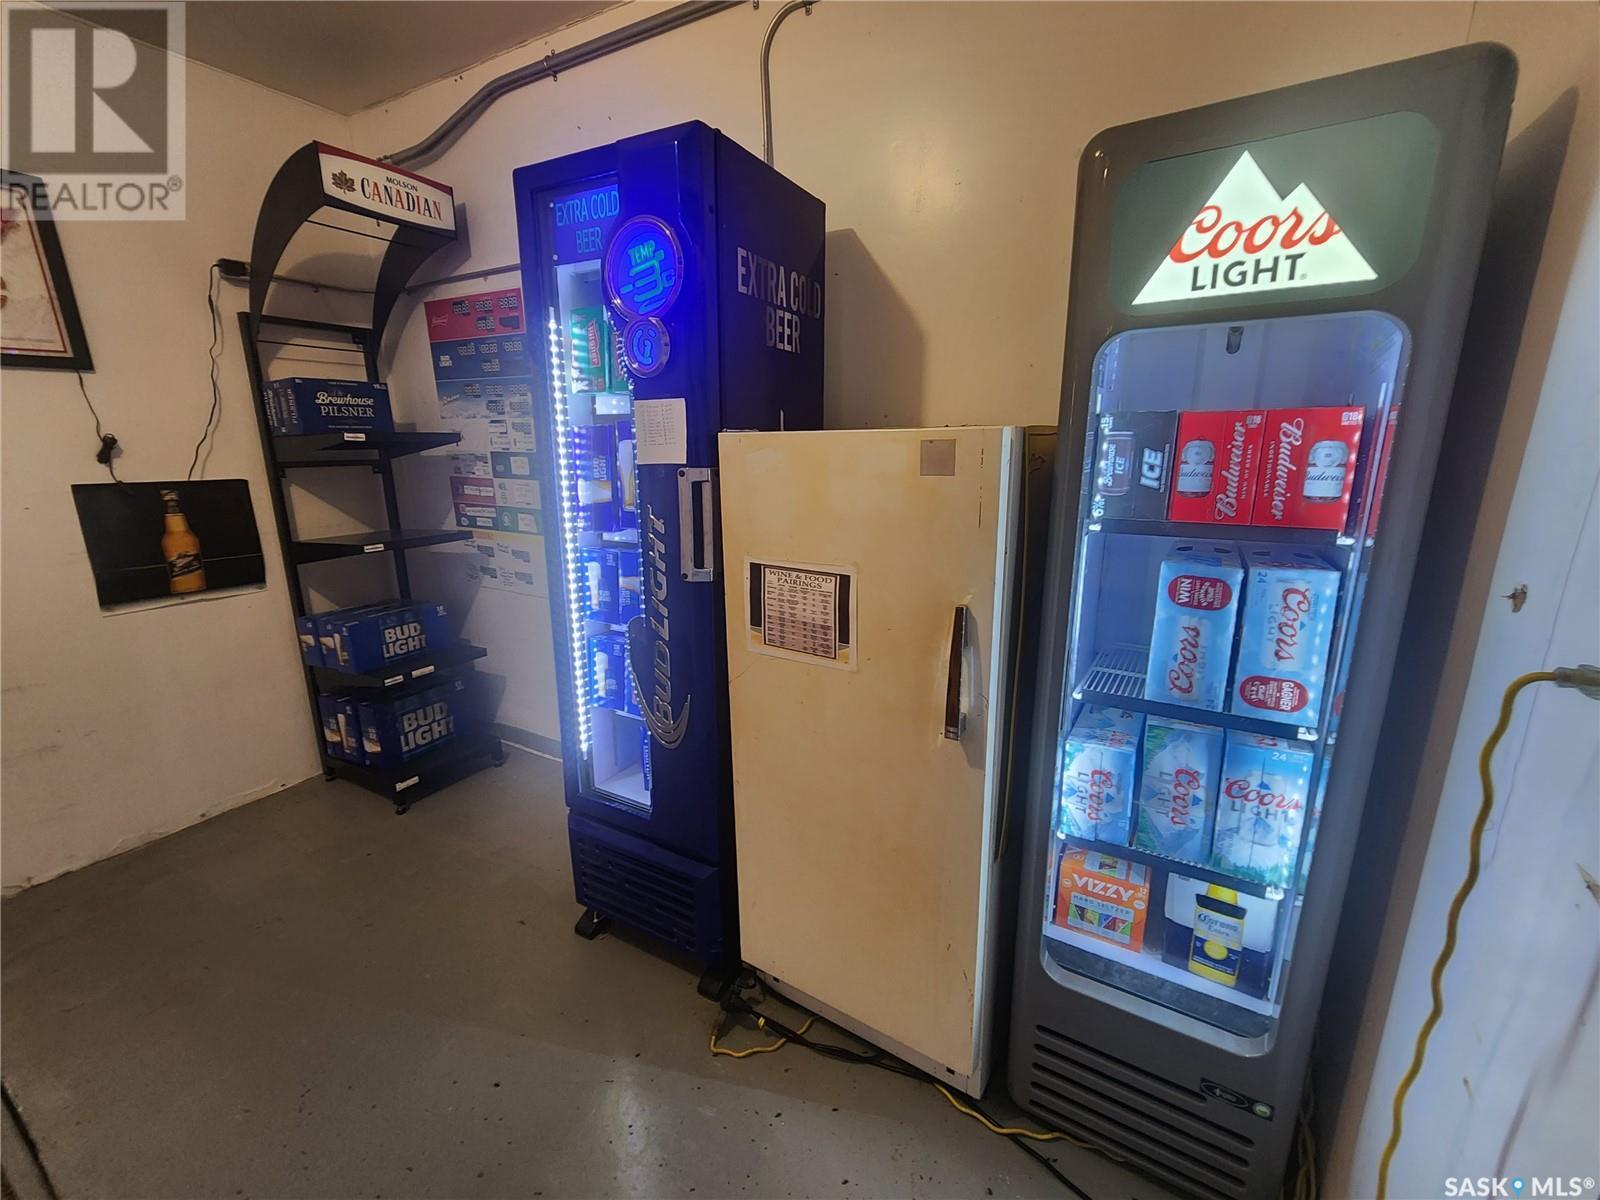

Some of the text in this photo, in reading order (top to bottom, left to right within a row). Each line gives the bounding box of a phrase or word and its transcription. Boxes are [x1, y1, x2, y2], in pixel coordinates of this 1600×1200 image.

[360, 177, 442, 220] CANADIAN
[386, 176, 418, 192] MOLSON
[556, 191, 620, 226] EXTRA COLD
[576, 227, 602, 253] BEER
[1168, 204, 1344, 263] Coors
[627, 240, 656, 265] TEMP
[737, 247, 821, 320] EXTRA COLD
[766, 306, 801, 353] BEER
[315, 391, 374, 406] Brewhouse
[321, 406, 375, 418] PILSNER
[1115, 456, 1125, 475] ICE
[1140, 447, 1163, 489] ICE
[1215, 421, 1246, 520] Budweiser
[1271, 418, 1304, 520] Budweiser
[768, 569, 793, 579] WINE
[804, 574, 833, 584] FOOD
[777, 577, 822, 589] PAIRINGS
[1178, 578, 1193, 604] WIN
[384, 622, 421, 642] BUD
[648, 504, 673, 727] BUD LIGHT
[1275, 586, 1310, 663] Coors
[382, 634, 427, 658] LIGHT
[1168, 624, 1201, 695] Coors
[1279, 681, 1295, 712] GAGNER
[400, 716, 454, 752] LIGHT
[402, 702, 449, 732] BUD
[1272, 752, 1287, 761] 24
[1075, 771, 1089, 815] LIGHT
[1087, 769, 1112, 821] Coors
[1155, 771, 1175, 818] LIGHT
[1170, 768, 1201, 826] Coors
[1224, 777, 1302, 811] Coors
[1230, 800, 1290, 823] LIGHT
[1072, 873, 1135, 902] VIZZY
